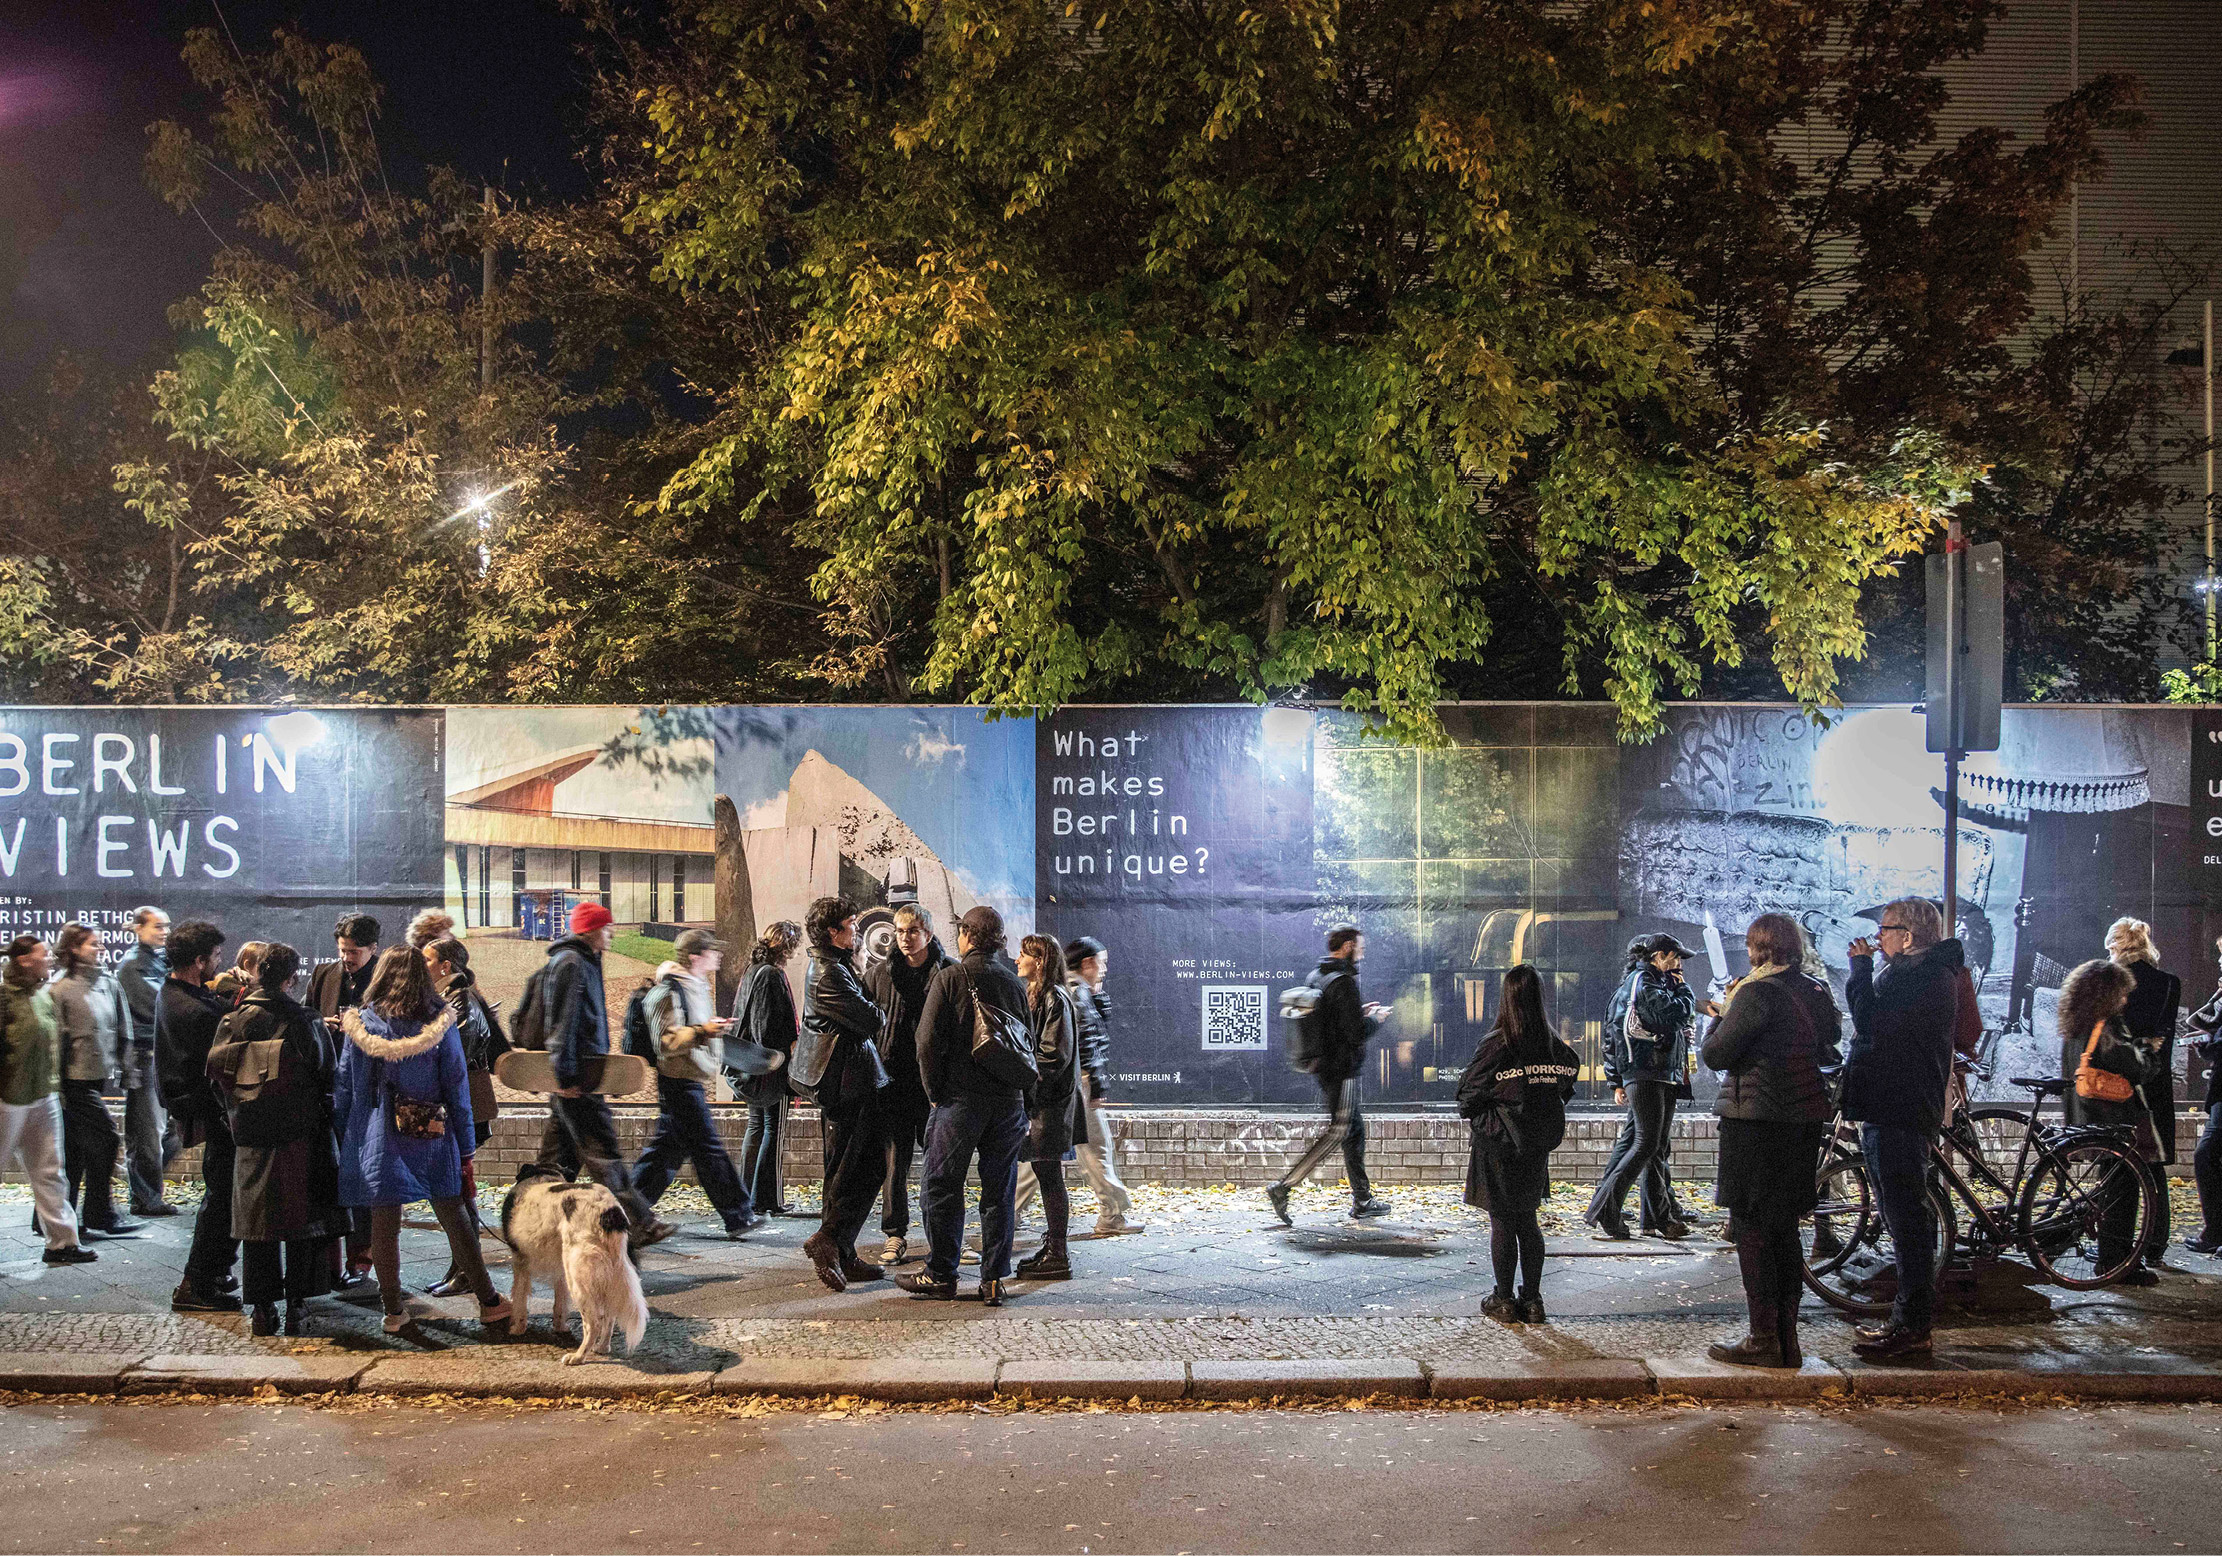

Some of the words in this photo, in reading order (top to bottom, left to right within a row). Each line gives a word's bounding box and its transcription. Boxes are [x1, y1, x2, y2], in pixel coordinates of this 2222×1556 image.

[1053, 730, 1142, 757] What
[0, 733, 297, 796] BERLIN
[1053, 770, 1165, 795] makes
[1053, 807, 1187, 835] Berlin
[0, 816, 240, 878] VIEWS
[1055, 847, 1209, 881] unique?
[0, 910, 66, 924] RISTIN
[78, 910, 134, 924] BETHG
[1172, 960, 1196, 968] MORE
[1202, 960, 1237, 968] VIEWS:
[1176, 971, 1295, 979] WWW.BERLIN-VIEWS.COM
[1119, 1073, 1141, 1081] VISIT
[1141, 1073, 1171, 1081] BERLIN
[1495, 1068, 1524, 1081] 032c
[1524, 1064, 1578, 1077] WORKSHOP
